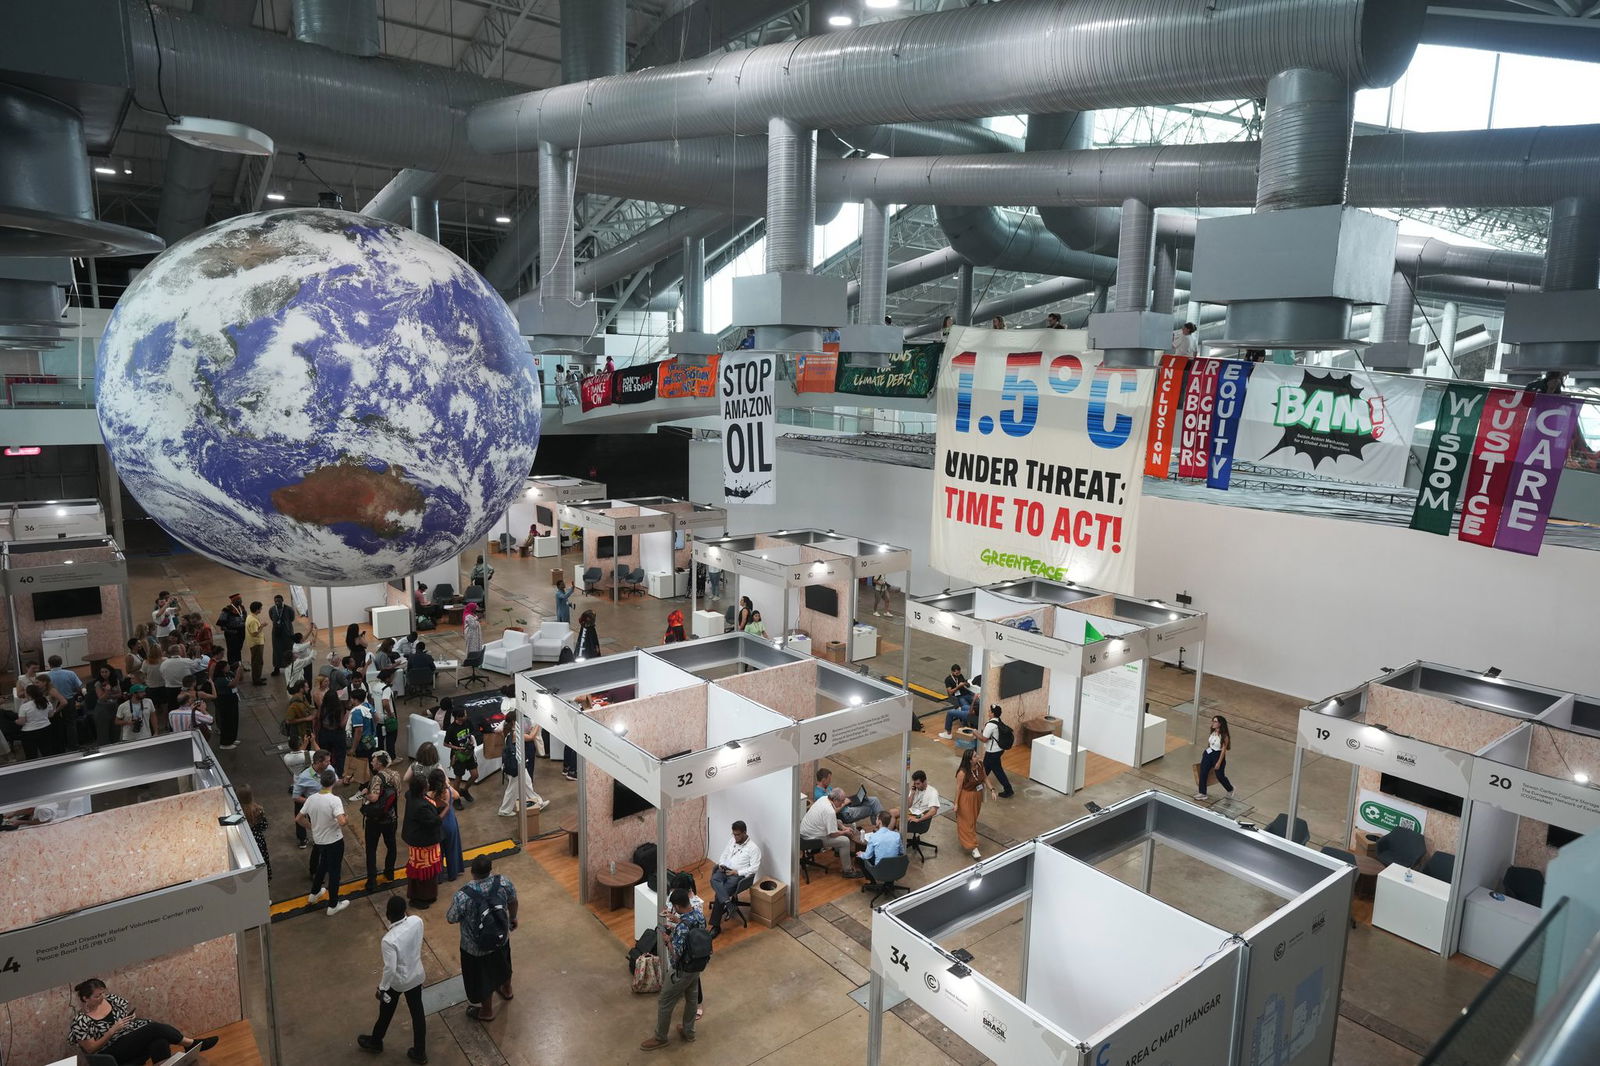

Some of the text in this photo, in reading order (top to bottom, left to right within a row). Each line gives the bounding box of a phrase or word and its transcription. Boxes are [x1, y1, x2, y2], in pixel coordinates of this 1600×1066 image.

[622, 384, 634, 393] THE
[723, 358, 771, 397] STOP
[853, 370, 914, 388] CLIMATE DEBT!
[724, 395, 772, 420] AMAZON
[1151, 357, 1177, 466] INCLUSION
[1181, 360, 1203, 466] LABOUR
[1194, 360, 1220, 467] RIGHTS
[1274, 384, 1386, 440] BAM!
[1211, 364, 1240, 480] EQUITY
[727, 421, 773, 473] OIL
[1419, 391, 1482, 511] WISDOM
[1462, 391, 1523, 536] JUSTICE
[1507, 409, 1567, 532] CARE
[945, 450, 1127, 505] UNDER THREAT:
[945, 486, 1122, 554] TIME TO ACT!
[980, 548, 1069, 582] GREENPEACE
[20, 576, 34, 584] 40
[914, 611, 921, 620] 15
[995, 631, 1004, 641] 16
[1089, 655, 1097, 664] 16
[521, 690, 528, 702] 31
[584, 732, 593, 747] 32
[813, 732, 828, 746] 30
[1315, 727, 1331, 741] 19
[1396, 754, 1417, 765] BRASIL
[677, 772, 694, 788] 32
[1488, 774, 1513, 790] 20
[35, 945, 59, 955] Peace
[59, 940, 78, 949] Boat
[79, 931, 108, 943] Disaster
[129, 917, 161, 929] Volunteer
[162, 910, 184, 921] Center
[0, 956, 21, 973] 4
[36, 953, 60, 963] Peace
[60, 947, 78, 956] Boat
[79, 943, 90, 951] US
[890, 945, 910, 973] 34
[982, 1017, 1007, 1040] BRASIL
[1151, 1039, 1158, 1052] C
[1160, 1024, 1180, 1047] MAP
[1185, 993, 1222, 1028] HANGAR
